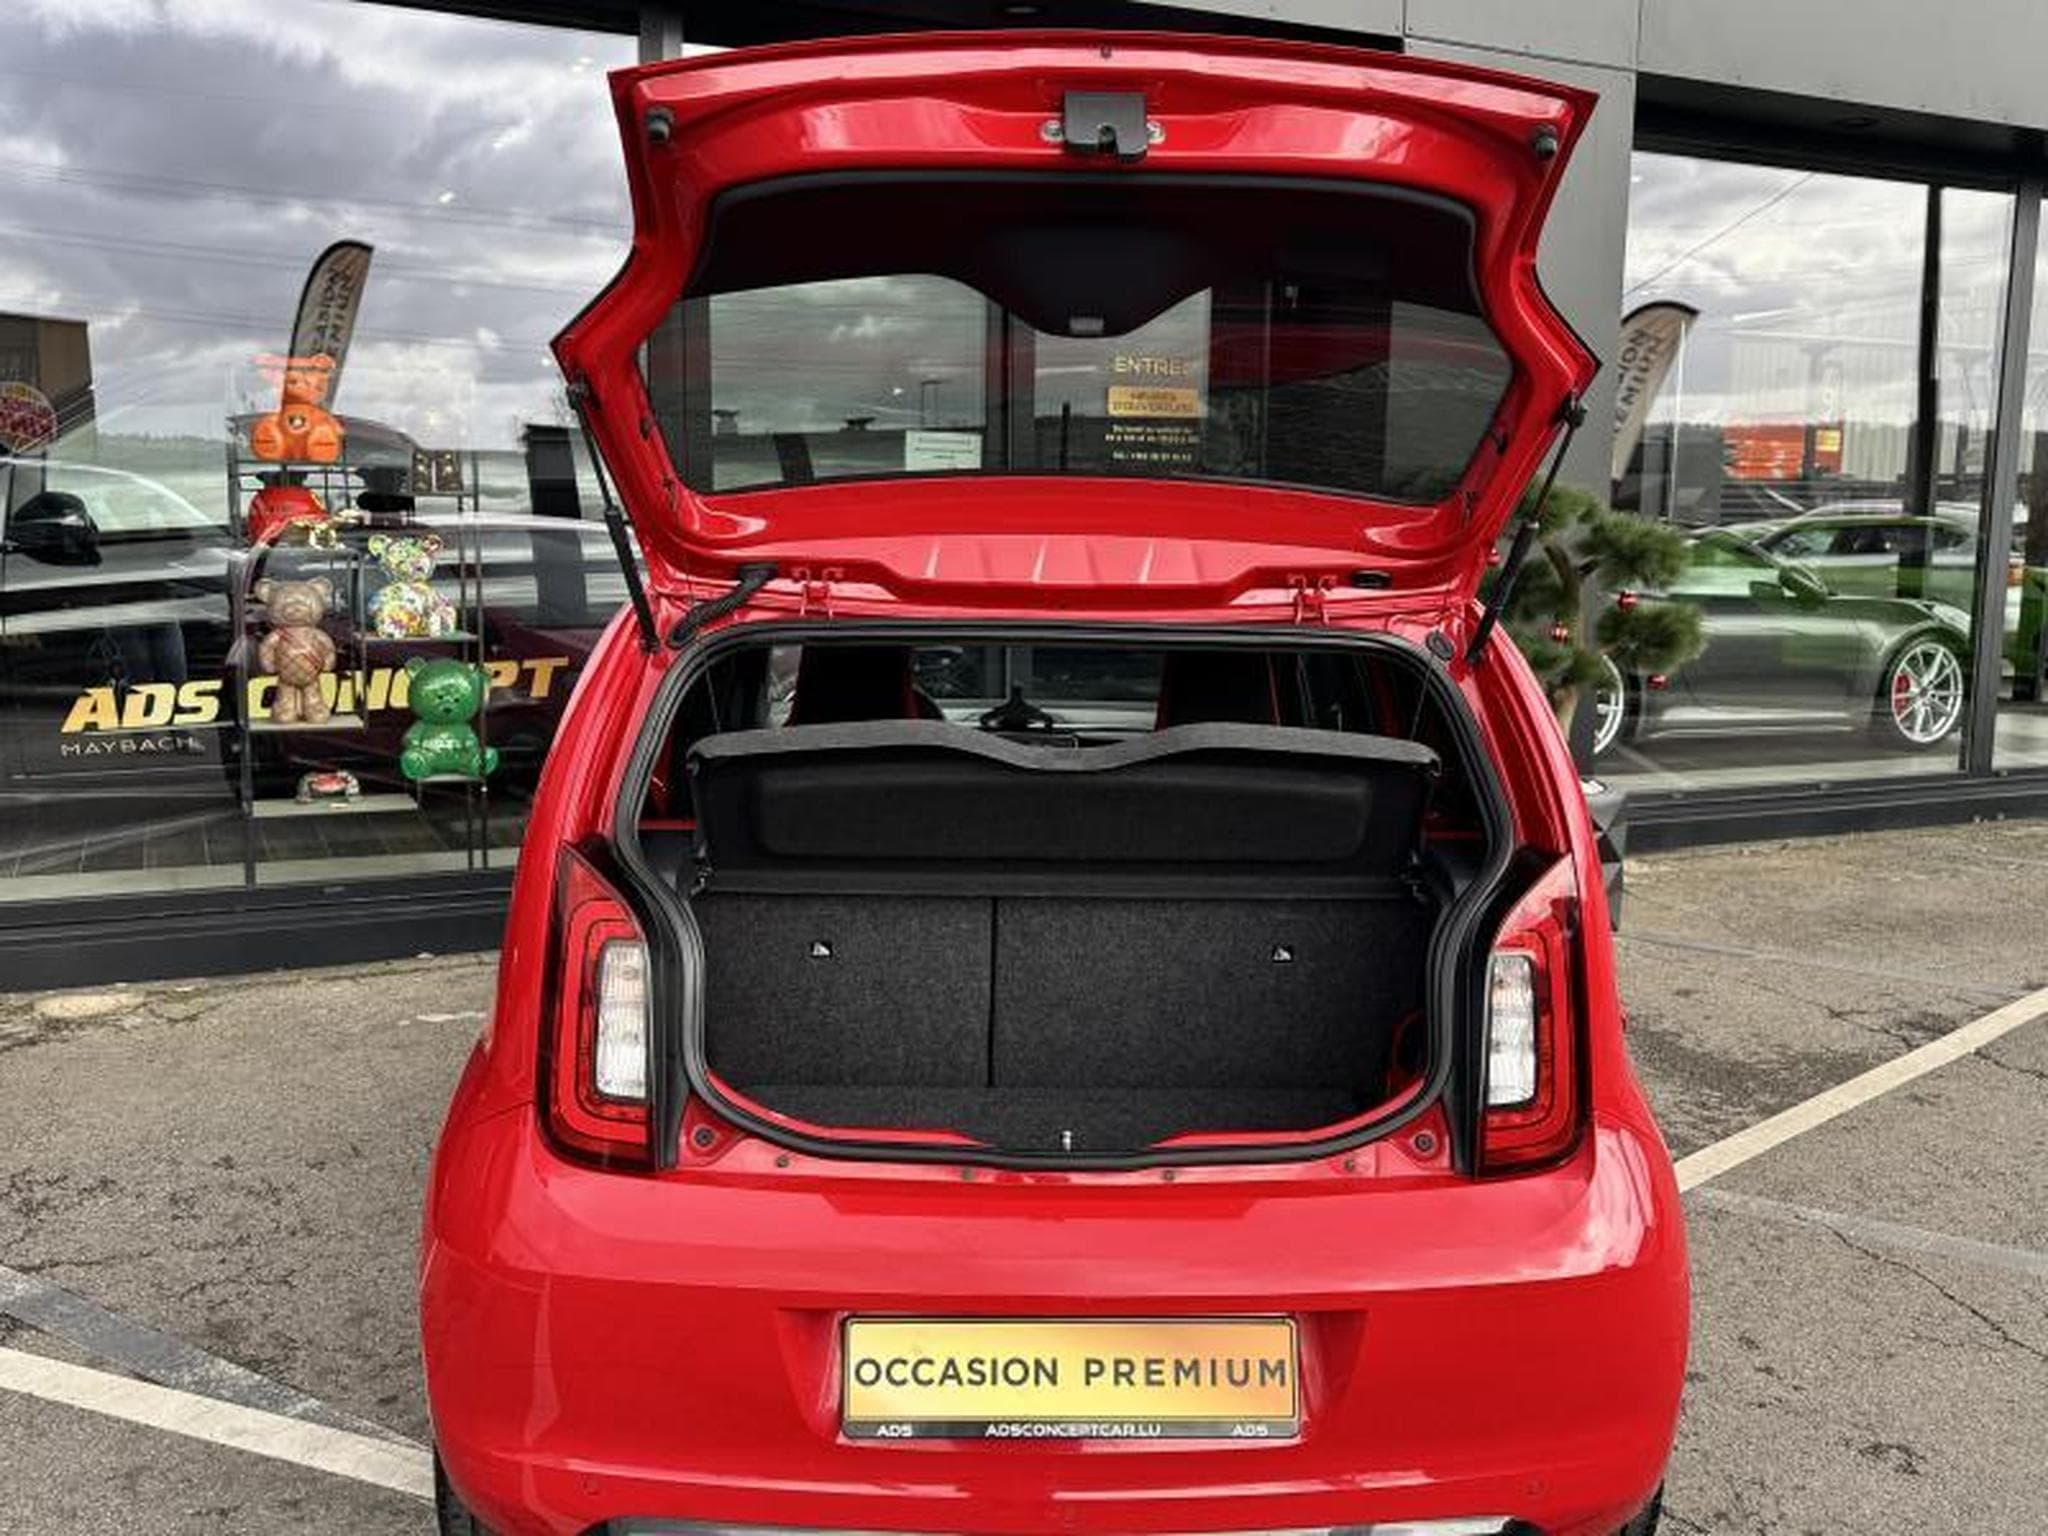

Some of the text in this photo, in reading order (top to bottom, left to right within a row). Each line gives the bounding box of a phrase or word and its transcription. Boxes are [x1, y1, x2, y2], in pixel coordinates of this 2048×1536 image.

[61, 656, 570, 733] ADS CNPT
[60, 736, 197, 758] MAYBACH
[854, 1357, 1287, 1387] OCCASION PREMIUM
[876, 1423, 913, 1438] ADS
[1231, 1423, 1269, 1438] ADS
